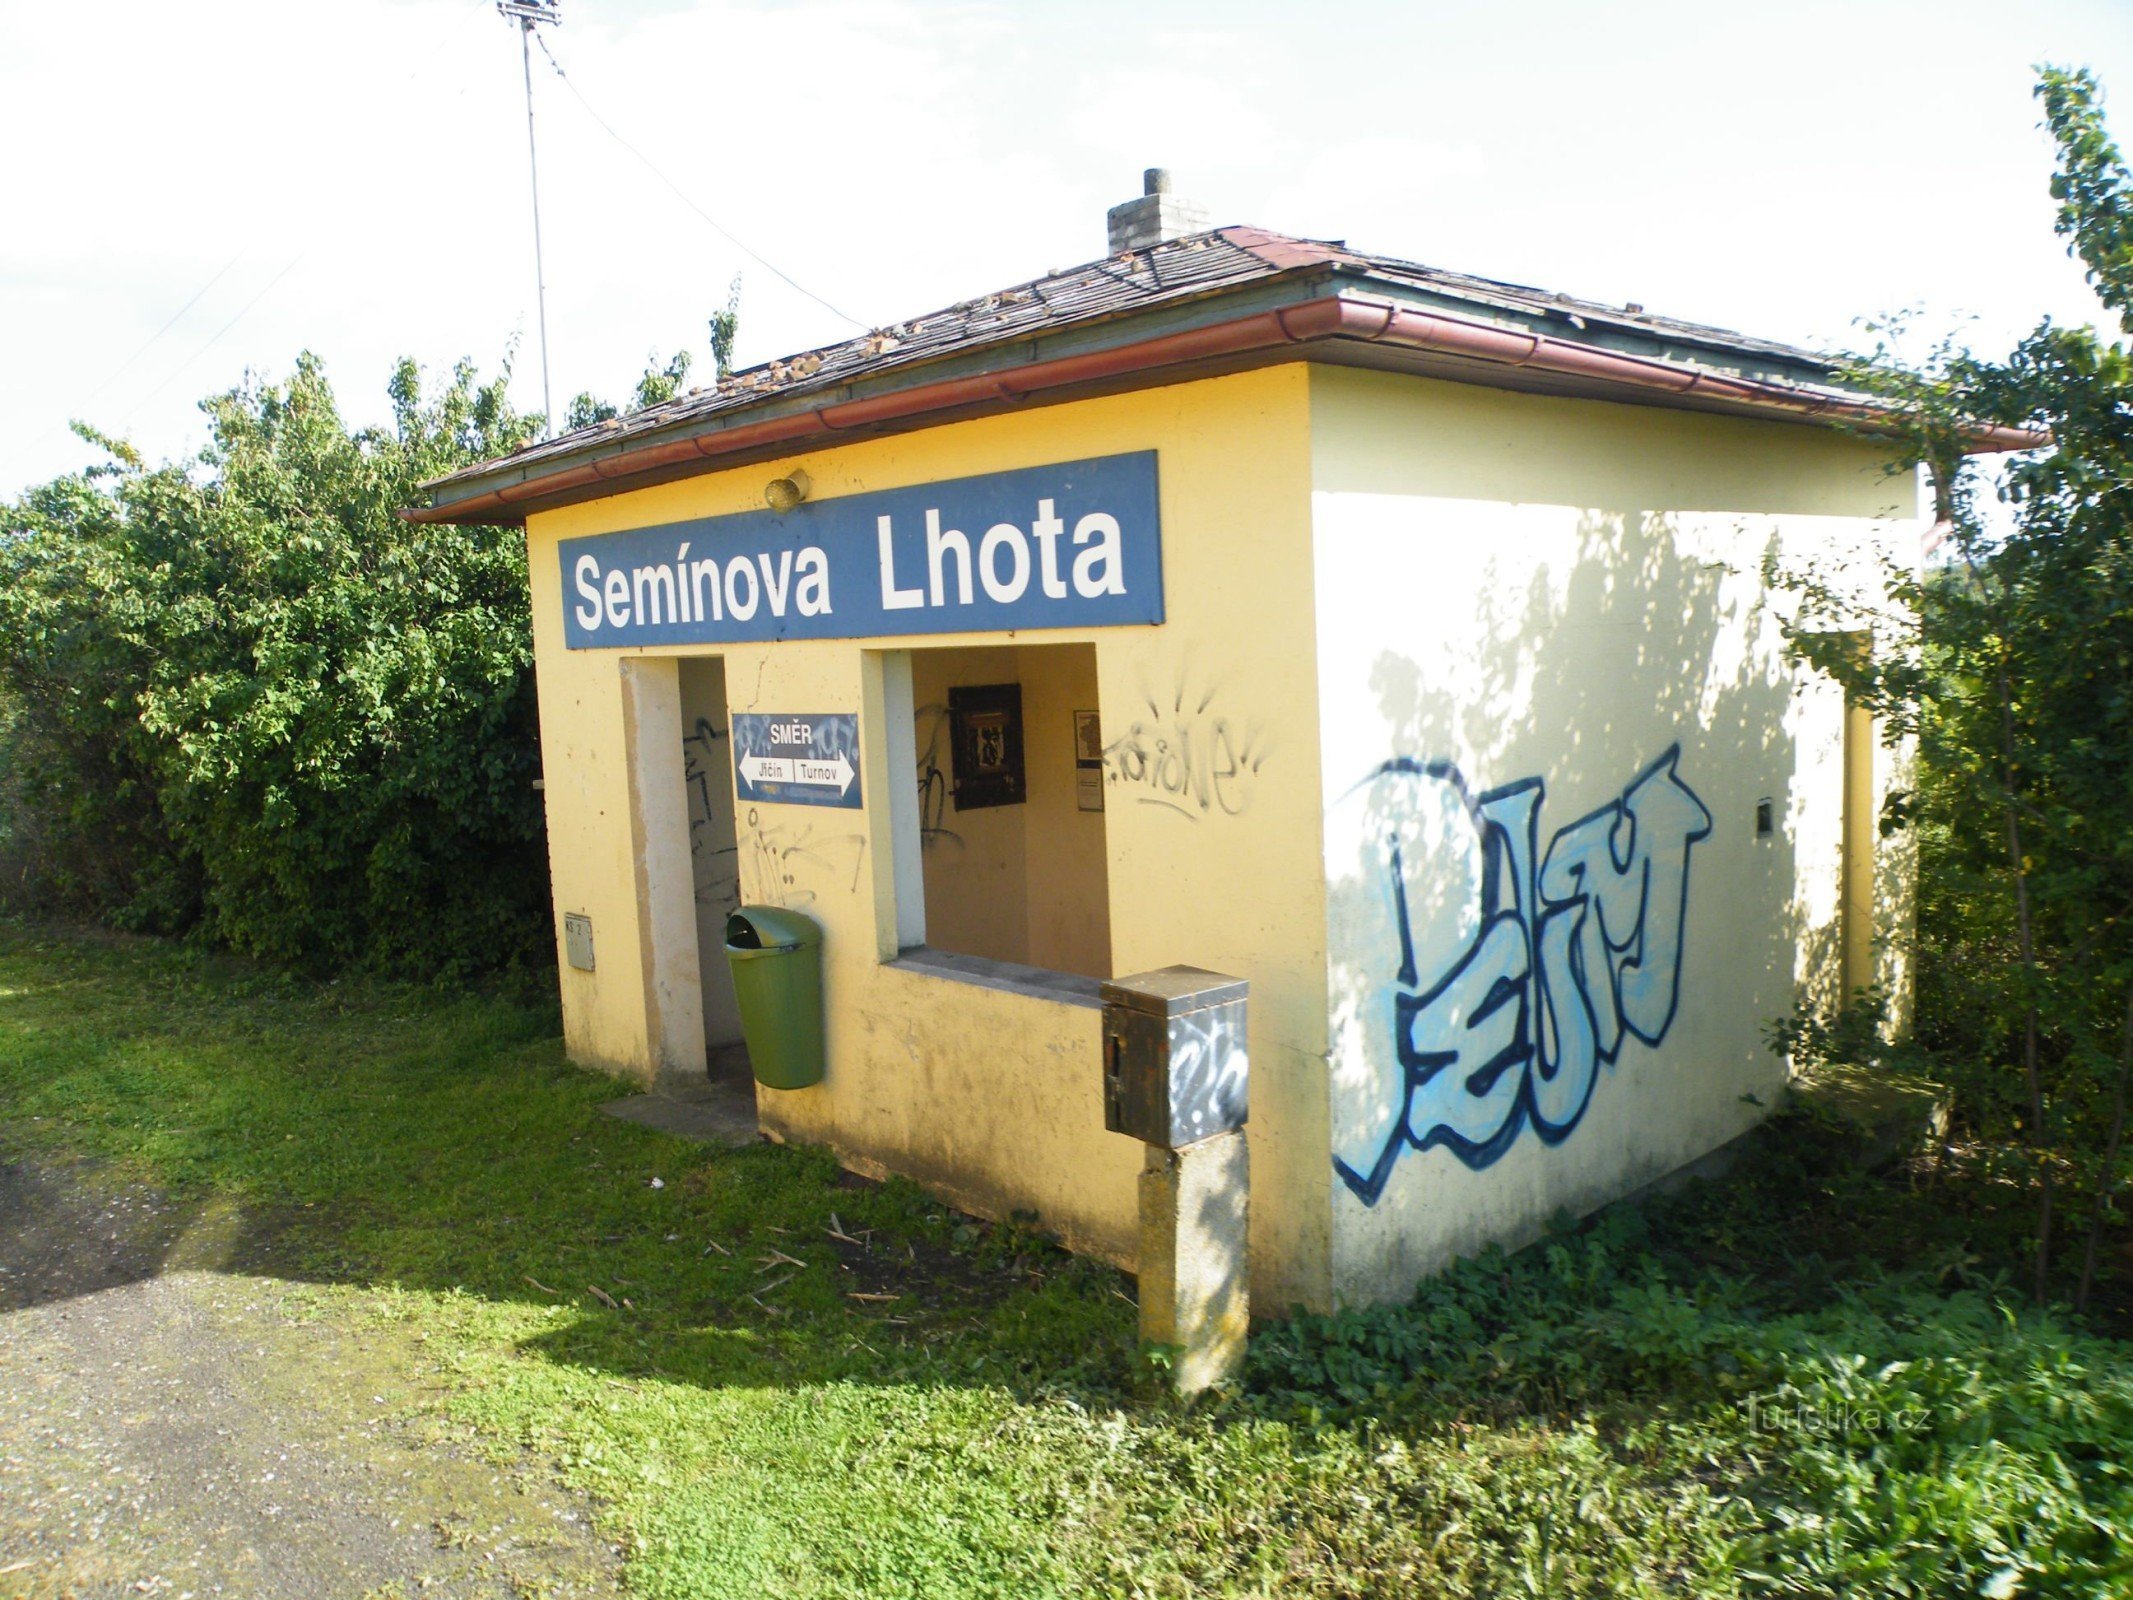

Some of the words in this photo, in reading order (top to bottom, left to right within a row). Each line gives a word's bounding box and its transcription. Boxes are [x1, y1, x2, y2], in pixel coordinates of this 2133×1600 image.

[575, 542, 833, 631] Semínova
[876, 498, 1128, 611] Lhota
[770, 718, 813, 745] SMĚR
[759, 762, 783, 778] Jičín
[800, 763, 837, 780] Turnov
